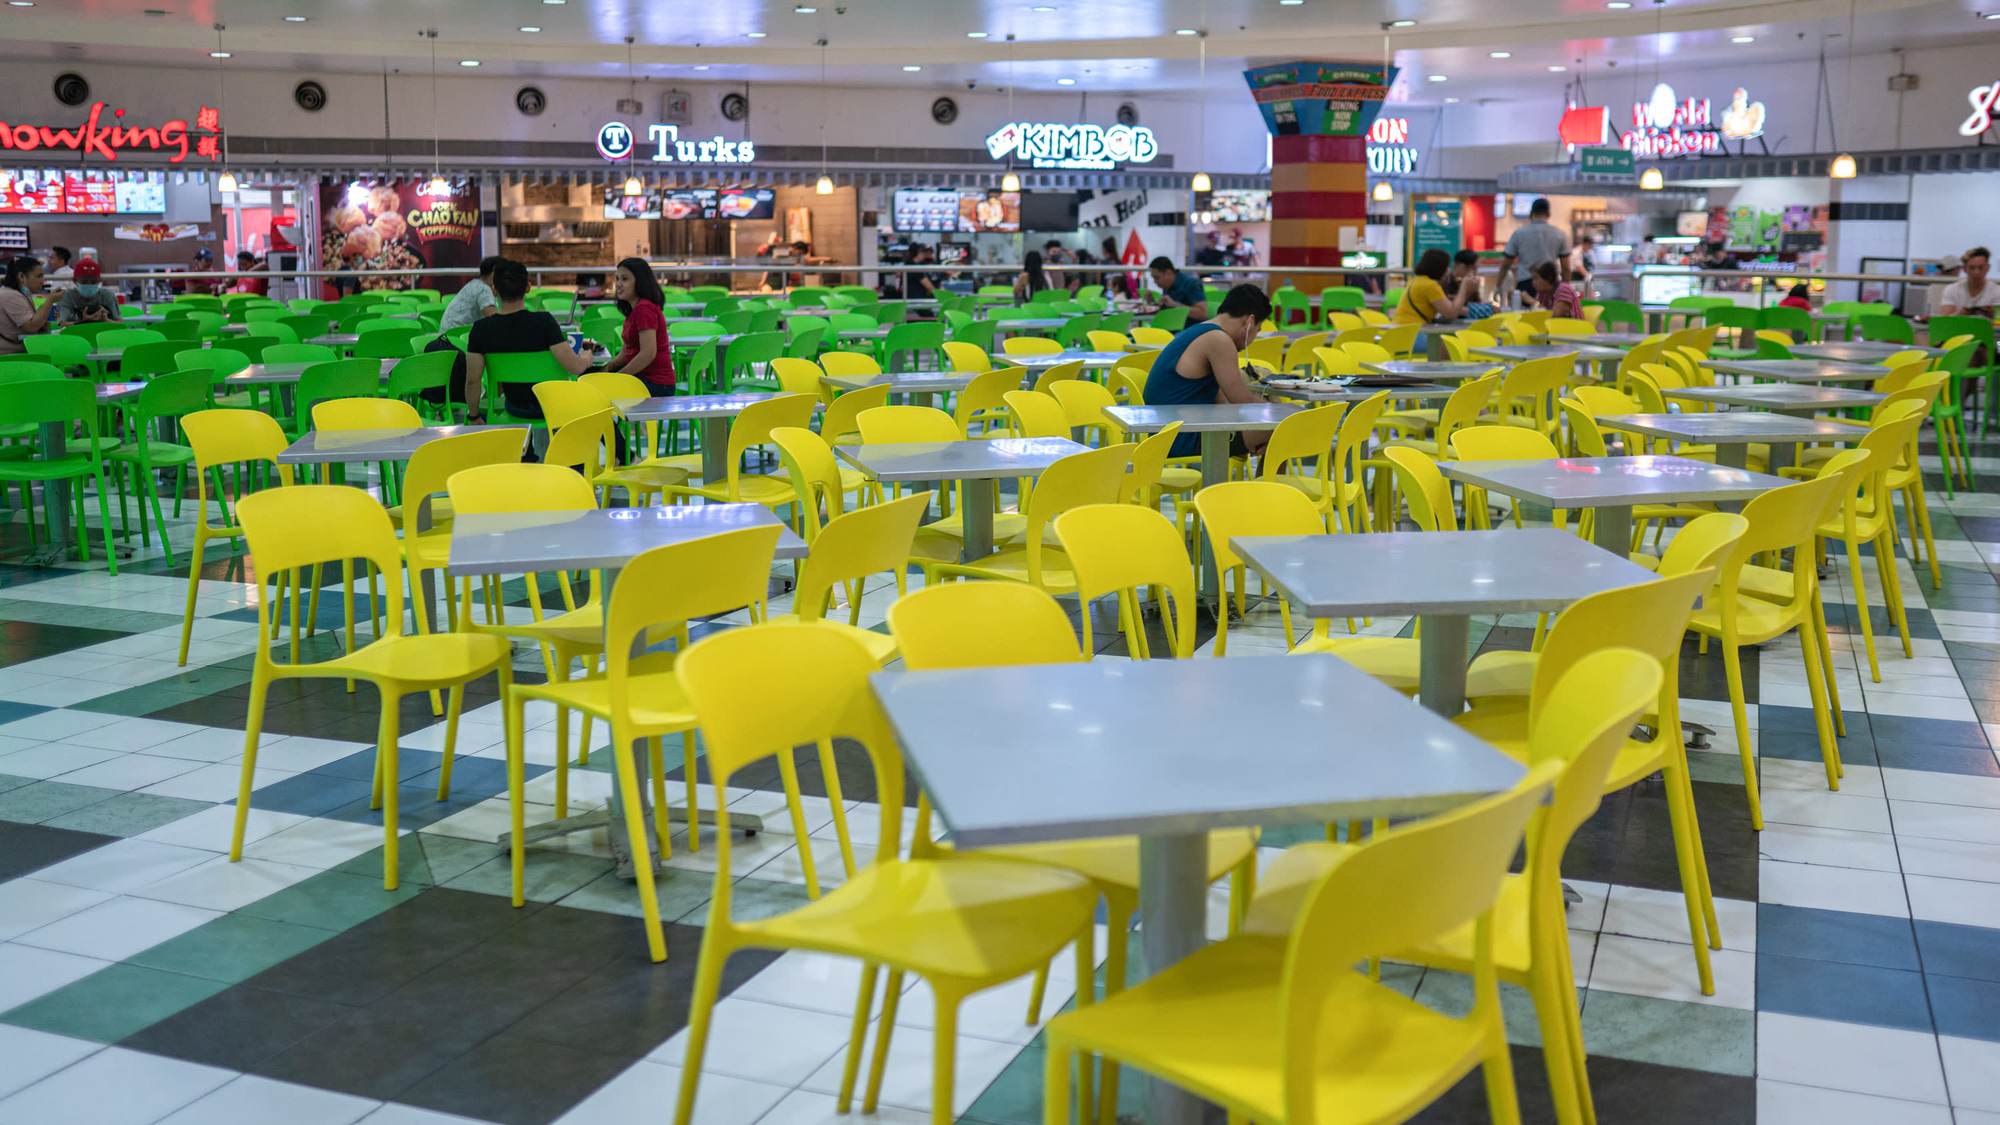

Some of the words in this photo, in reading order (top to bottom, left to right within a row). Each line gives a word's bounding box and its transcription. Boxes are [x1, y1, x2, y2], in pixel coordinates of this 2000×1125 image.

[606, 127, 625, 150] T
[648, 124, 755, 162] Turks
[1018, 122, 1158, 162] KIMBOB
[1620, 126, 1719, 157] Chicken
[1366, 147, 1418, 173] ORY
[407, 209, 451, 227] CHAO
[452, 208, 479, 227] FAN
